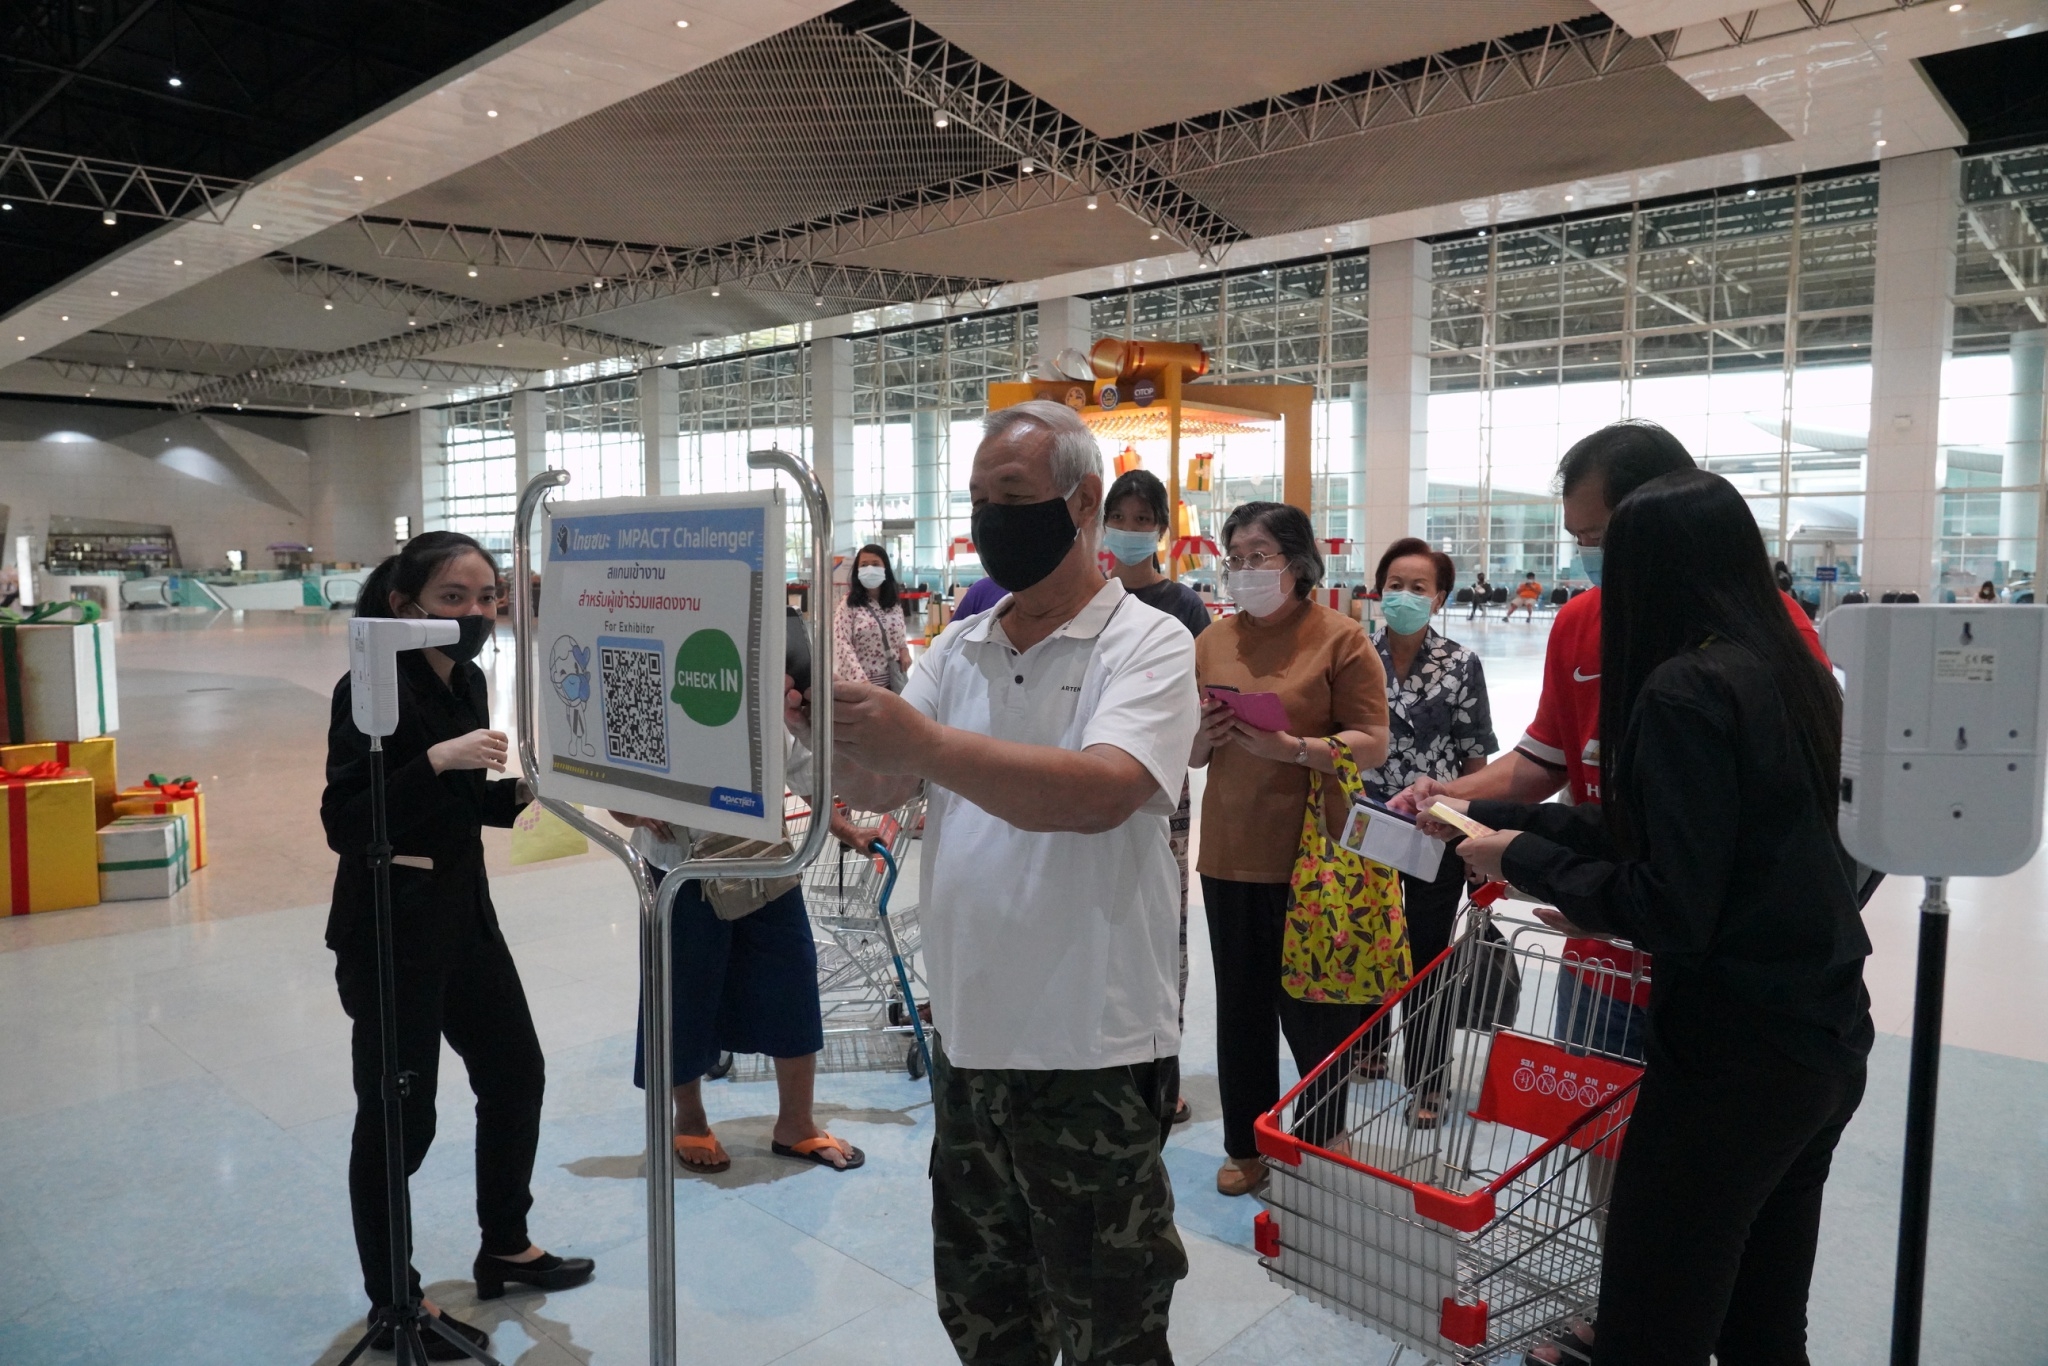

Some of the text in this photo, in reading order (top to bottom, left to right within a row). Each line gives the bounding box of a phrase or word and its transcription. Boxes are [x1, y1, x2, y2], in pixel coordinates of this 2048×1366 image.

[573, 526, 754, 553] ไทยชนะ IMPACT Challenger
[607, 562, 665, 580] สแกนเข้างาน
[578, 589, 701, 614] สำหรับผู้เข้าร่วมแสดงงาน
[604, 620, 655, 634] For Exhibitor
[677, 668, 739, 693] CHECK IN
[1520, 1058, 1535, 1069] YES
[1543, 1064, 1556, 1074] NO
[1563, 1070, 1577, 1080] NO
[1584, 1076, 1599, 1087] NO
